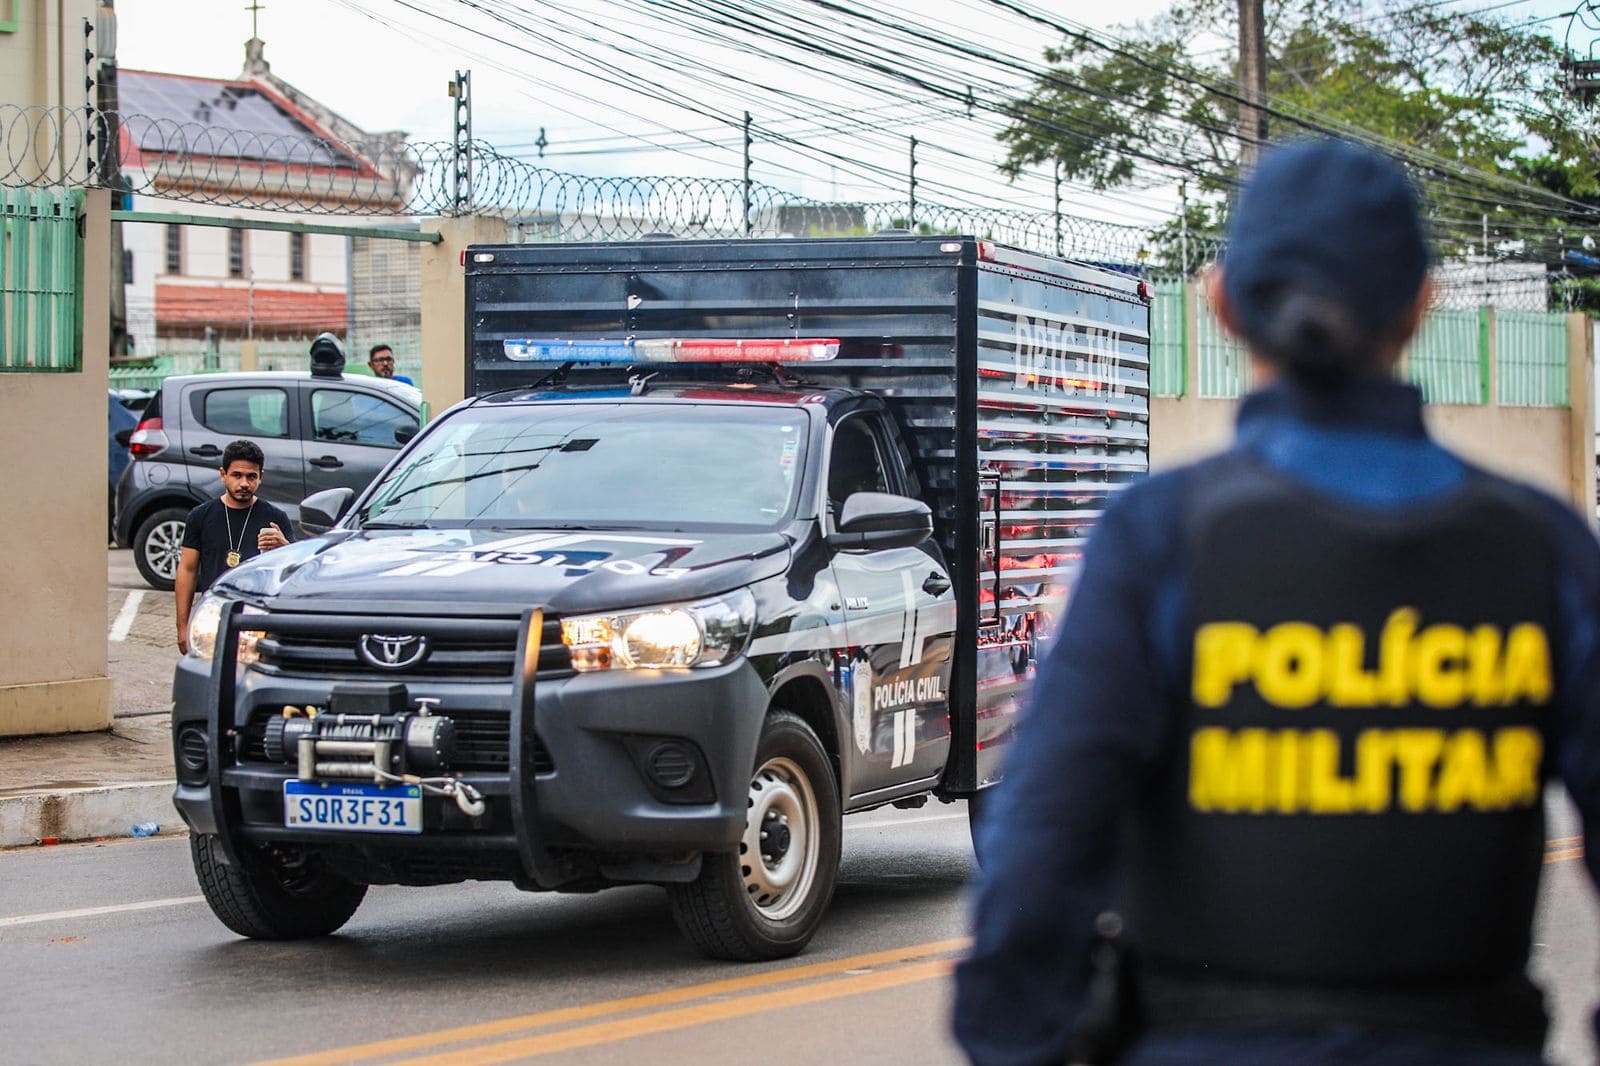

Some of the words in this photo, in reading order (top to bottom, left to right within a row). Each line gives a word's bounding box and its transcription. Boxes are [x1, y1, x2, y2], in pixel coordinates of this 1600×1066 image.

[1193, 606, 1553, 708] POLÍCIA
[874, 676, 915, 710] POLÍCIA
[917, 675, 943, 701] CIVIL
[1190, 726, 1544, 813] MILITAR
[300, 797, 407, 826] SQR3F31
